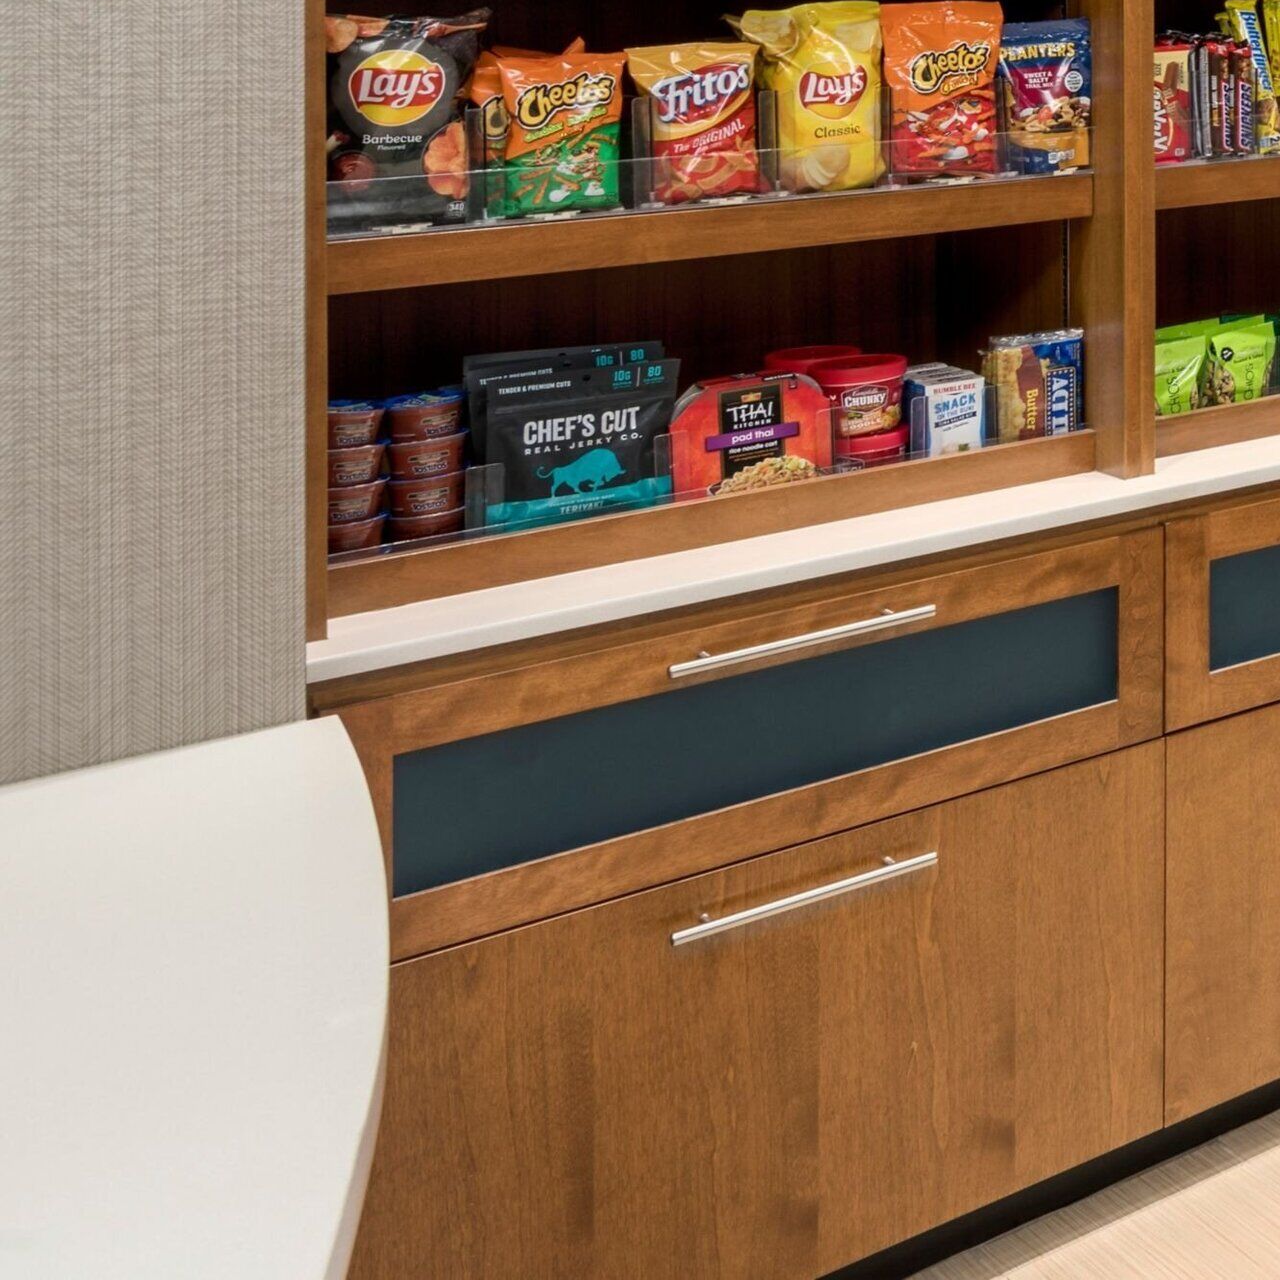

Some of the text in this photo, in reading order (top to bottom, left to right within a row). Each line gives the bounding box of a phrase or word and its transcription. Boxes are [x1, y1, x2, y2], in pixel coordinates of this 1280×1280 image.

[1000, 42, 1076, 62] PLANTERS
[1240, 10, 1272, 91] Butterfinger
[911, 43, 990, 92] Cheetos
[1024, 71, 1043, 80] SWEET
[358, 69, 440, 109] Lay's
[803, 70, 866, 106] Lay's
[1028, 76, 1049, 85] SALTY
[517, 73, 616, 129] Cheetos
[651, 63, 750, 122] Fritos
[1239, 82, 1254, 149] SNICKERS
[362, 133, 423, 145] Barbecue
[673, 118, 745, 154] The ORIGINAL
[814, 124, 861, 139] Classic
[629, 348, 645, 361] 80
[612, 369, 631, 382] 10G
[647, 365, 662, 377] 80
[498, 380, 571, 395] TENDER PREMIUM CUTS
[1051, 376, 1069, 412] ACT
[844, 392, 887, 408] CHUNKY
[934, 393, 976, 414] SNACK
[1025, 388, 1039, 431] Butter
[726, 400, 775, 423] THAI
[522, 405, 641, 447] CHEF'S CUT
[733, 418, 772, 430] KITCHEN
[524, 432, 643, 457] REAL JERKY CO.
[731, 427, 774, 446] pad thai
[728, 439, 778, 455] rice noodle cart
[413, 460, 448, 474] TOSTITOS
[413, 498, 448, 512] TOSTITOS
[559, 500, 605, 515] TERIYAKI
